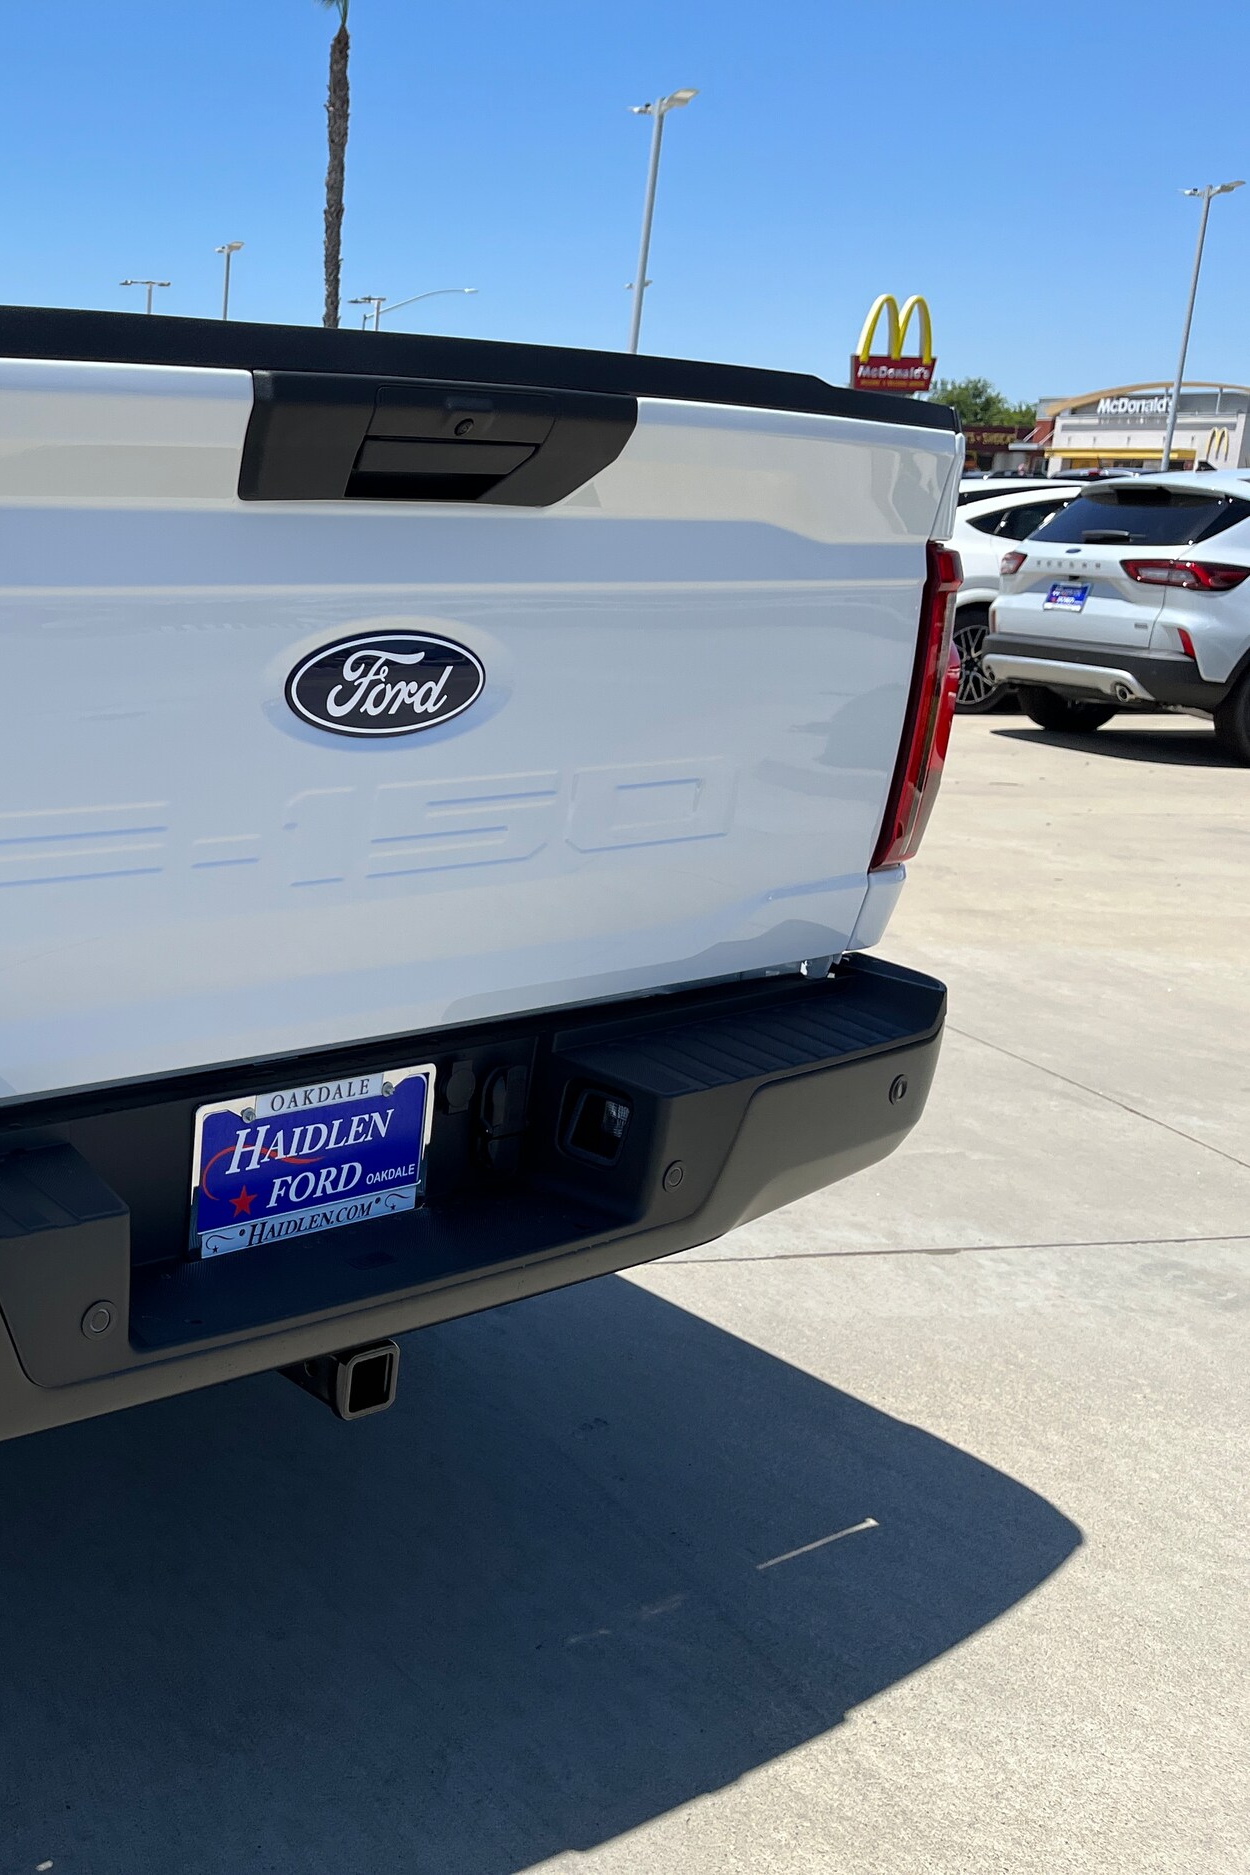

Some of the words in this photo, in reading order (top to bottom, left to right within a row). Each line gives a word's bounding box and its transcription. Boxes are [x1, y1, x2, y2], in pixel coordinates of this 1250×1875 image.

[857, 364, 931, 380] McDonald's
[326, 649, 454, 718] Ford
[270, 1078, 371, 1113] OAKDALE
[225, 1108, 395, 1176] HAIDLEN
[266, 1161, 363, 1208] FORD
[365, 1163, 415, 1185] OAKDALE
[246, 1200, 374, 1248] HAIDLEN.COM
